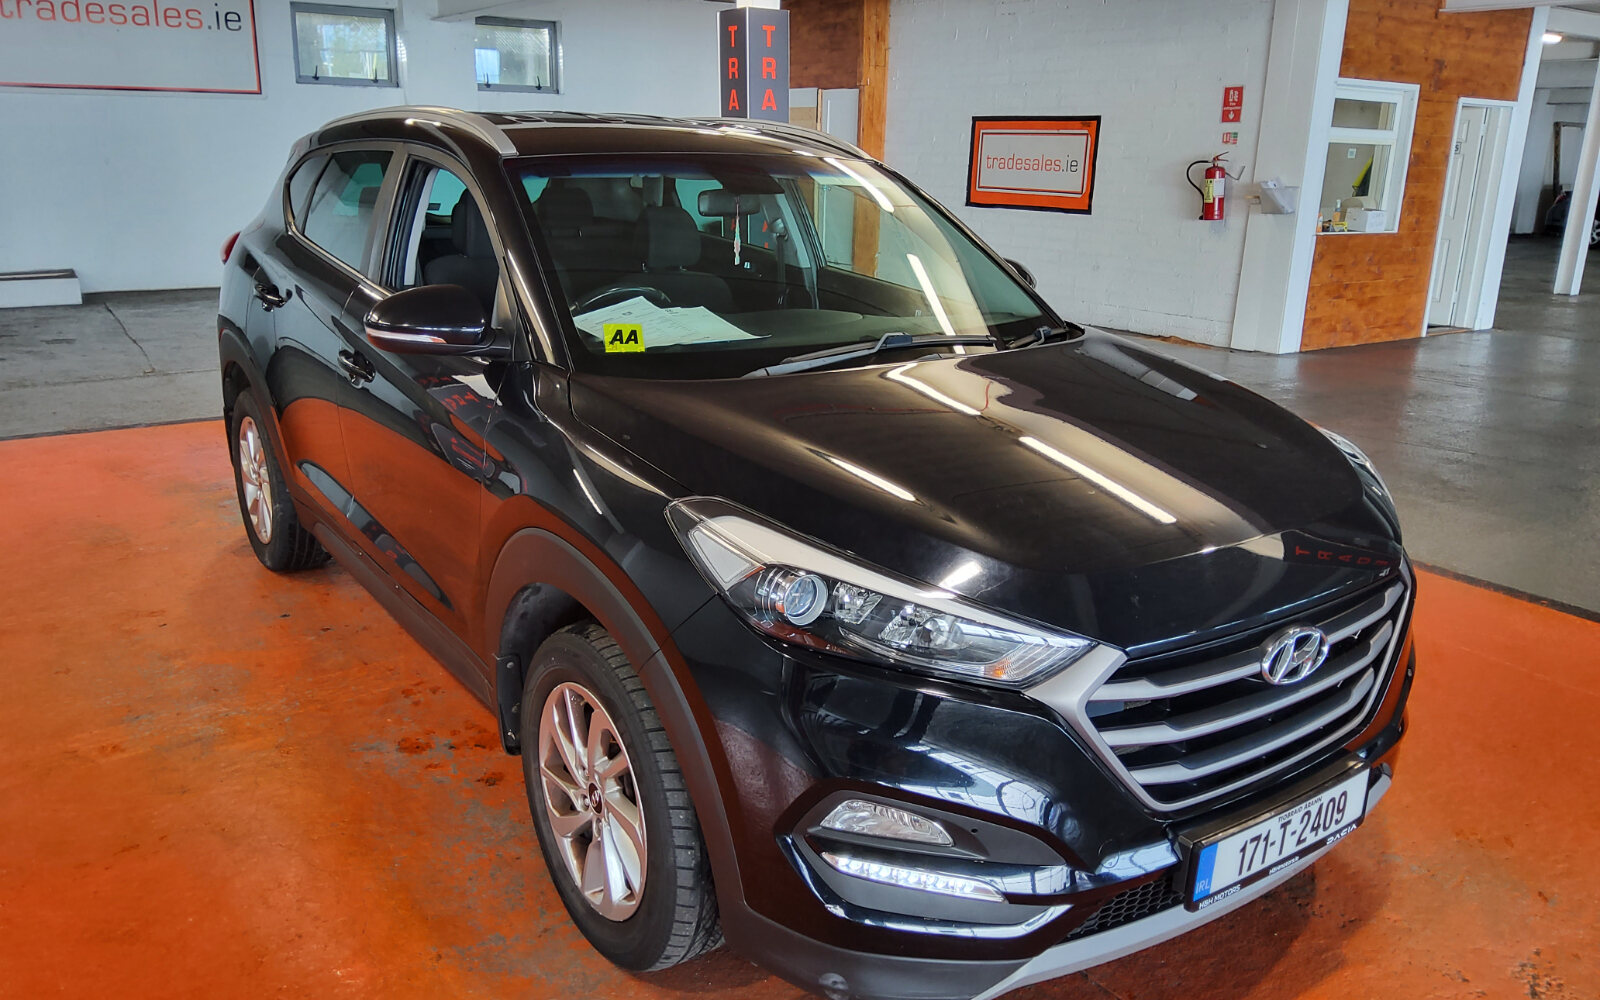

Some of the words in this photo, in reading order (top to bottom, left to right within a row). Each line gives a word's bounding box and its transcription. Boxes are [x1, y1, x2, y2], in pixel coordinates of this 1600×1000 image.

[0, 0, 242, 32] tradesales.ie
[986, 153, 1079, 173] tradesales.ie
[609, 329, 639, 346] AA
[1238, 790, 1348, 876] 171-T-2409
[1326, 823, 1357, 845] DACIA
[1195, 878, 1210, 895] IRL
[1213, 884, 1241, 902] MOTORS
